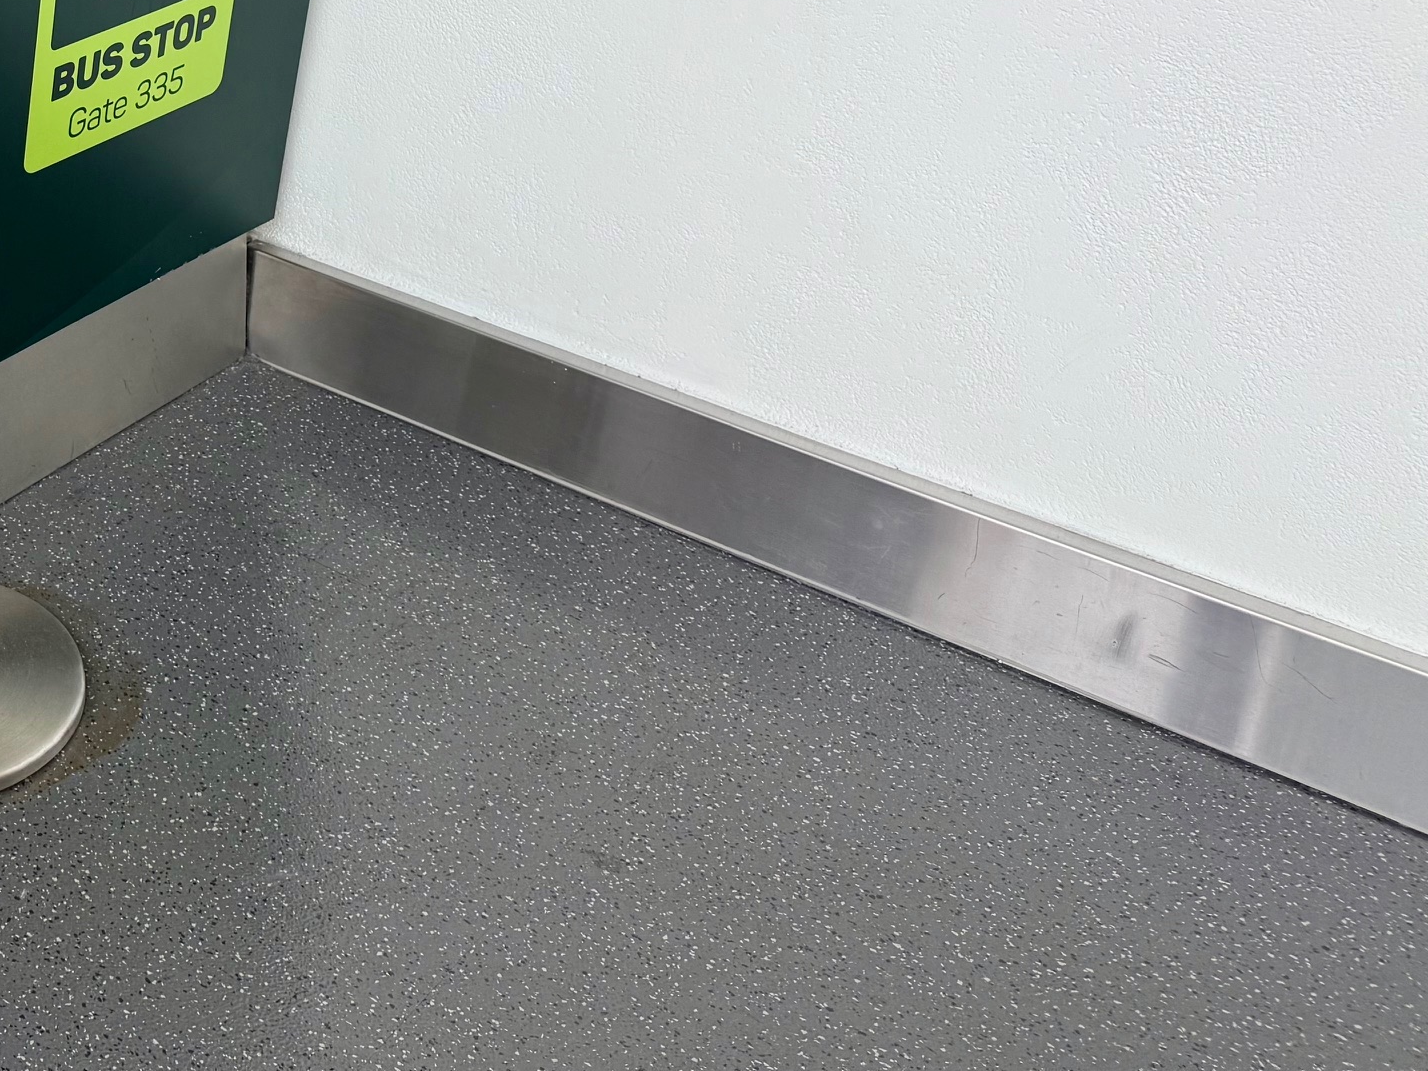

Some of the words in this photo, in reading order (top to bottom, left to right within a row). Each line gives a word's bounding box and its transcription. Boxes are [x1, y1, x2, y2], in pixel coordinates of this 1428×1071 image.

[51, 40, 124, 103] BUS
[129, 5, 218, 69] STOP
[68, 94, 128, 139] Gate
[135, 63, 186, 111] 335
